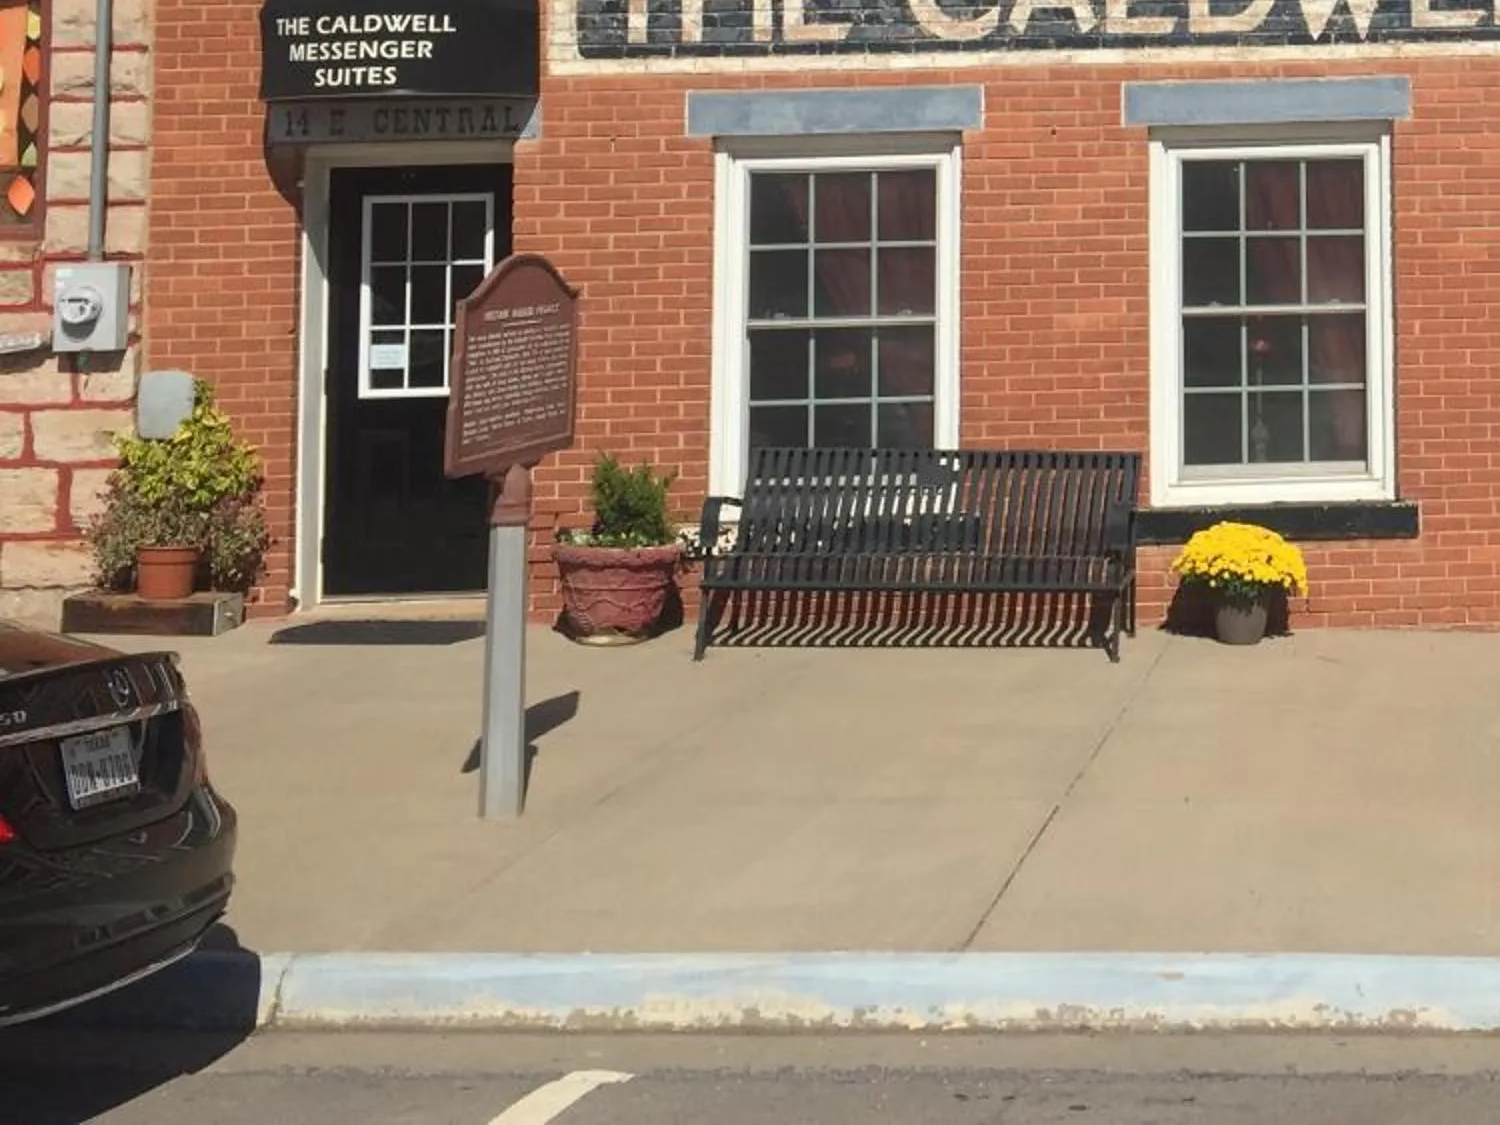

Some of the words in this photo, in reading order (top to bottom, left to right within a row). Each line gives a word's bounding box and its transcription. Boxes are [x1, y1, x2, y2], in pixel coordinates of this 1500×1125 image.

[275, 16, 310, 37] THE
[315, 13, 457, 35] CALDWELL
[288, 39, 434, 63] MESSENGER
[313, 65, 398, 88] SUITES
[284, 109, 309, 137] 14
[373, 104, 520, 135] CENTRAL
